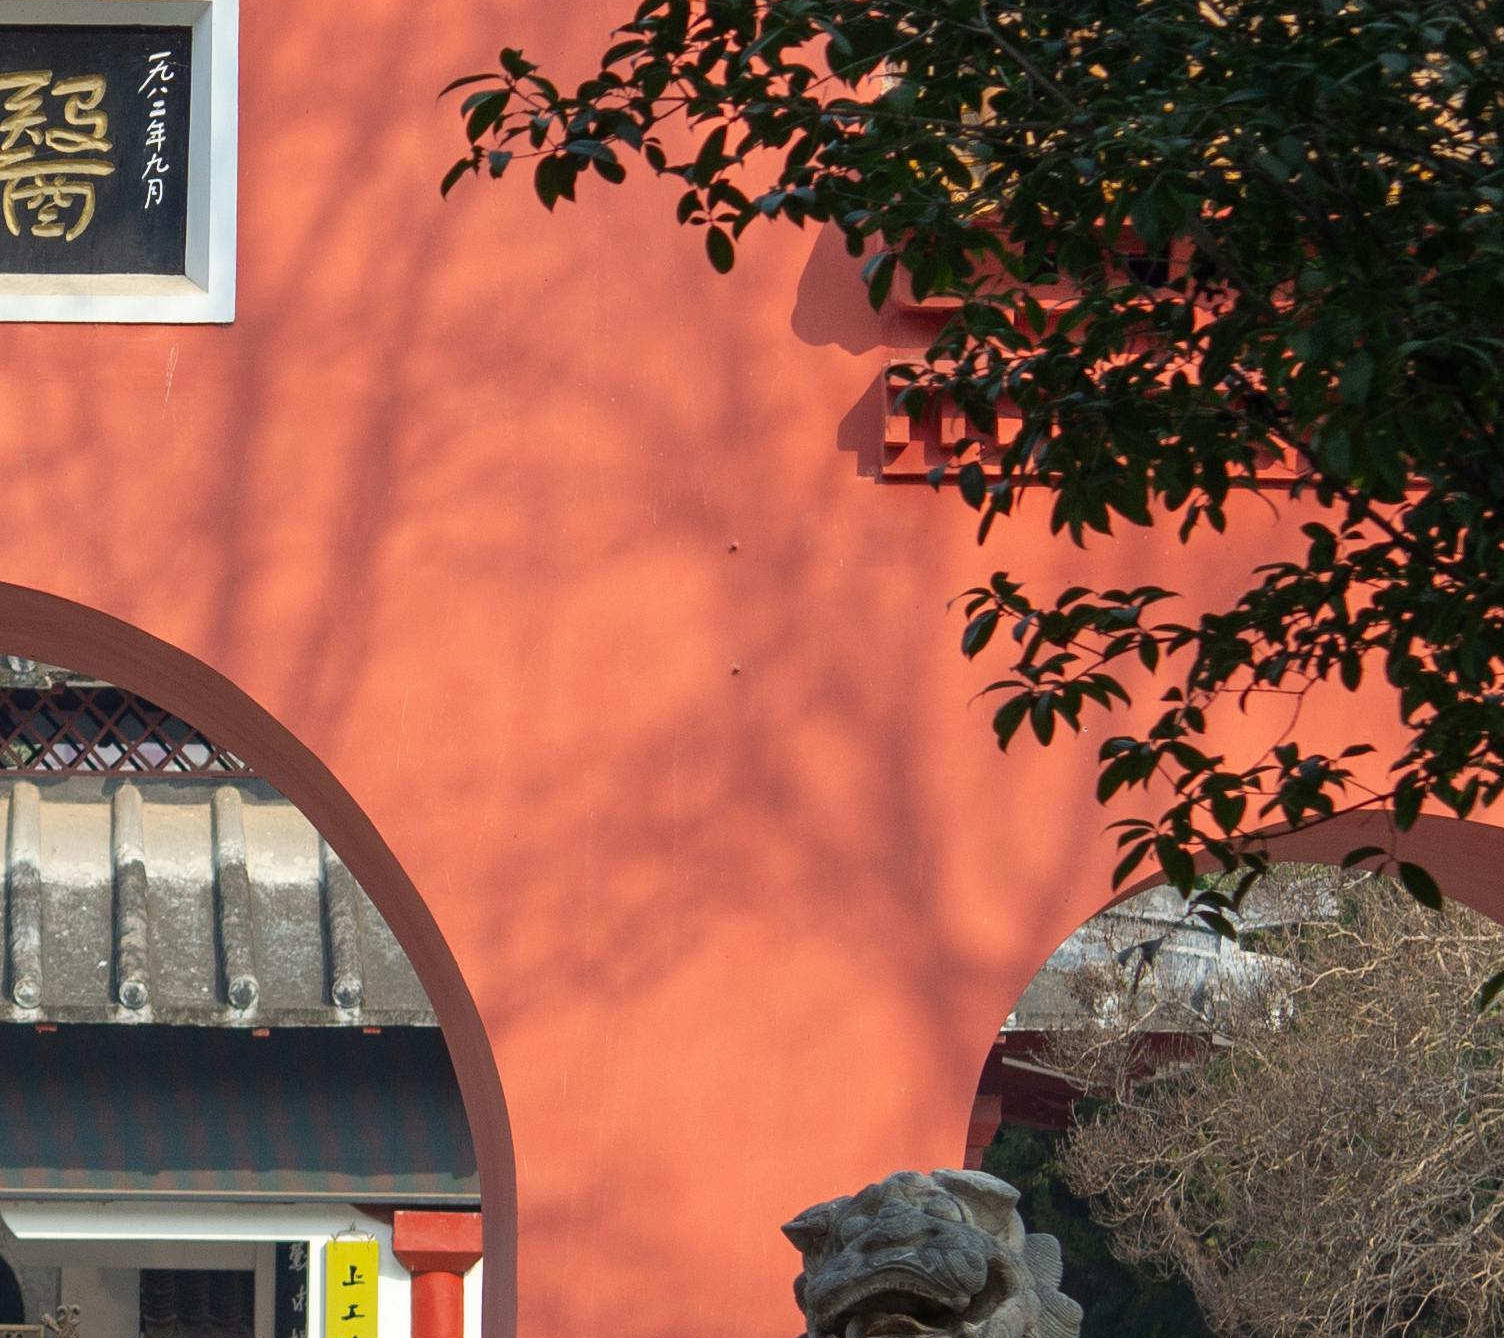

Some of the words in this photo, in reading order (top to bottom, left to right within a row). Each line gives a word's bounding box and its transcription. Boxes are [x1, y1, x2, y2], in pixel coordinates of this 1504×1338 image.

[138, 51, 175, 209] 一九八二年九月
